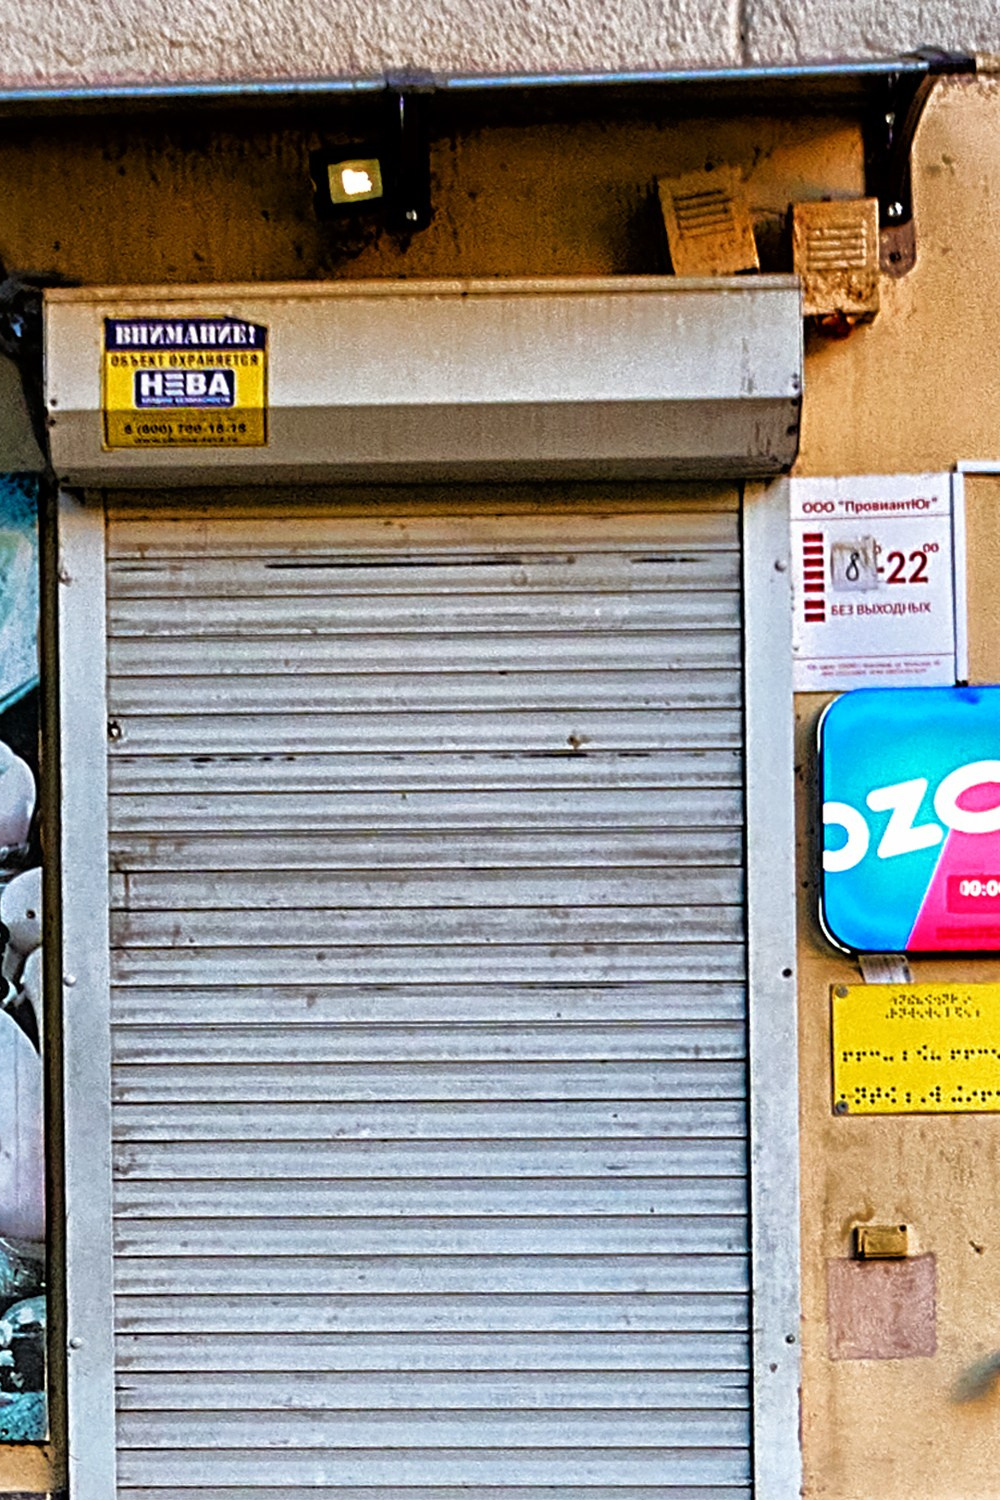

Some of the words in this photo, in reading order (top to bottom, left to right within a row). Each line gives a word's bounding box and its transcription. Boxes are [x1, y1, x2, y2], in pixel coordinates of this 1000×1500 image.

[114, 324, 256, 345] ВНИМАНИЕ!
[110, 354, 164, 368] ОБЪЕКТ
[168, 354, 259, 368] ОХРАНЯЕТСЯ
[140, 372, 231, 397] НЕВА
[802, 501, 835, 514] ООО
[838, 496, 938, 515] "ПровиантЮг"
[831, 603, 854, 617] БЕЗ
[856, 601, 932, 617] ВЫХОДНЫХ
